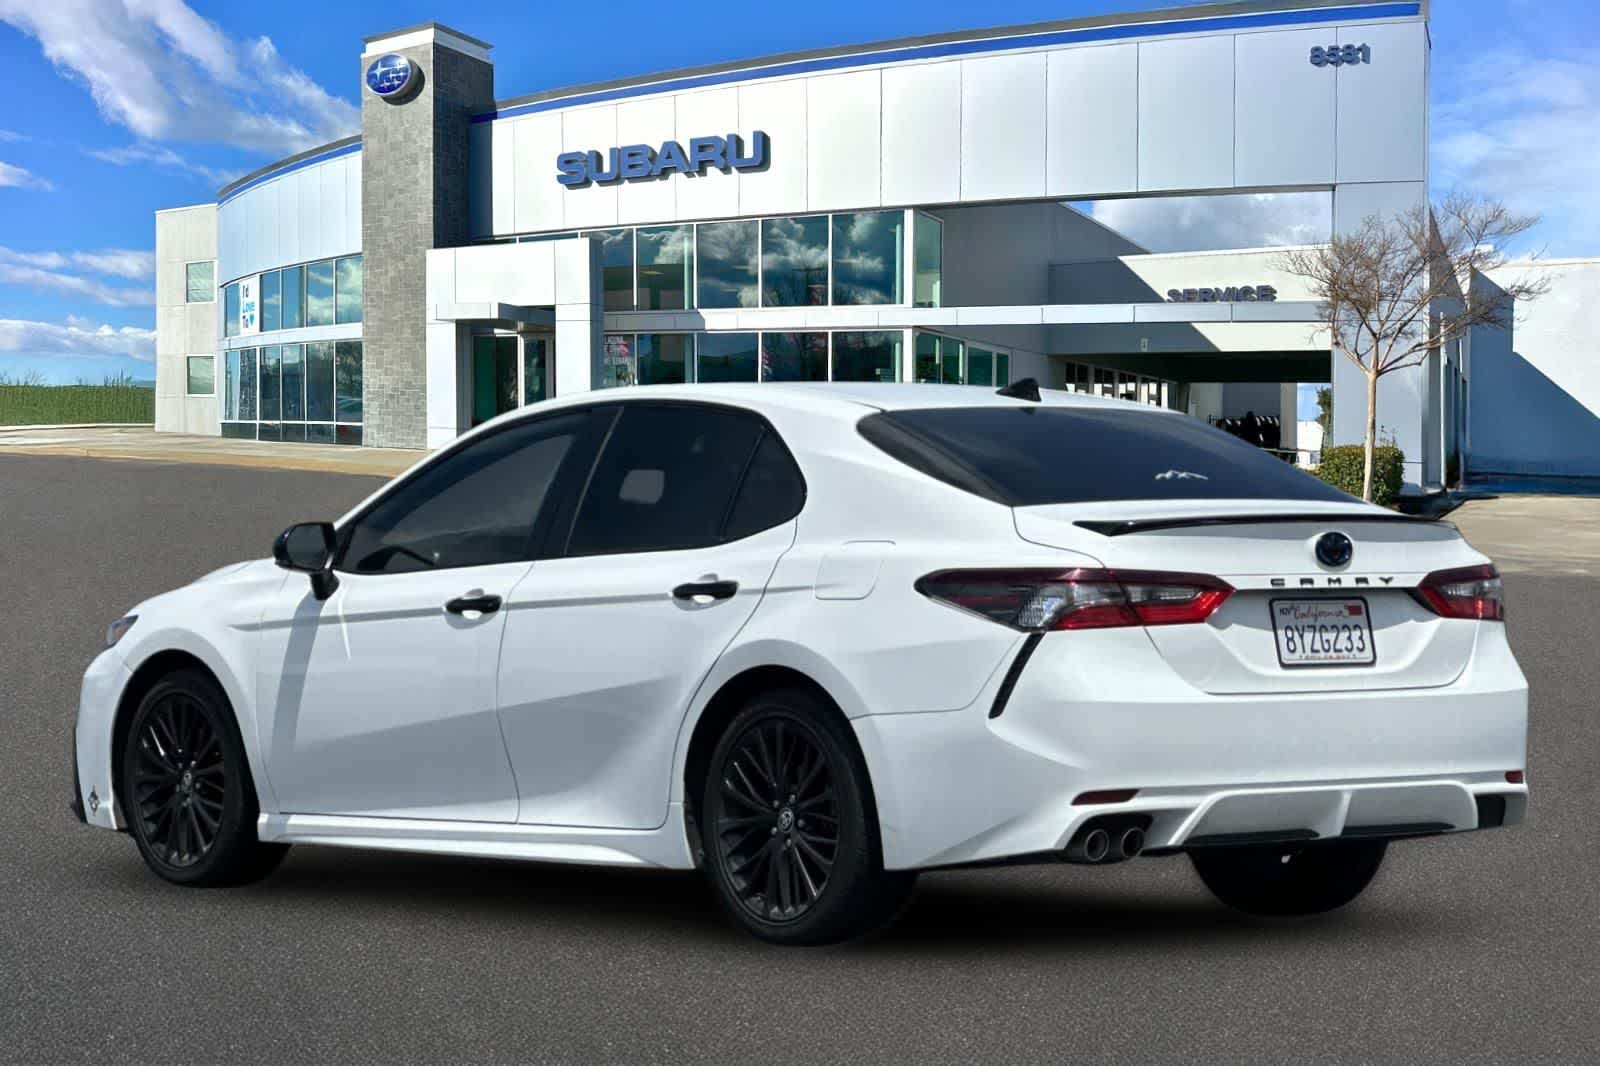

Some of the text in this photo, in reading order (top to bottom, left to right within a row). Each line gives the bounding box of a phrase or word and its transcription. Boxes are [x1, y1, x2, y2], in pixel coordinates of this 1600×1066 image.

[557, 130, 770, 190] SUBARU
[1167, 285, 1277, 302] SERVICE
[1270, 576, 1394, 587] CAMRY
[1284, 624, 1366, 653] 8YZG233
